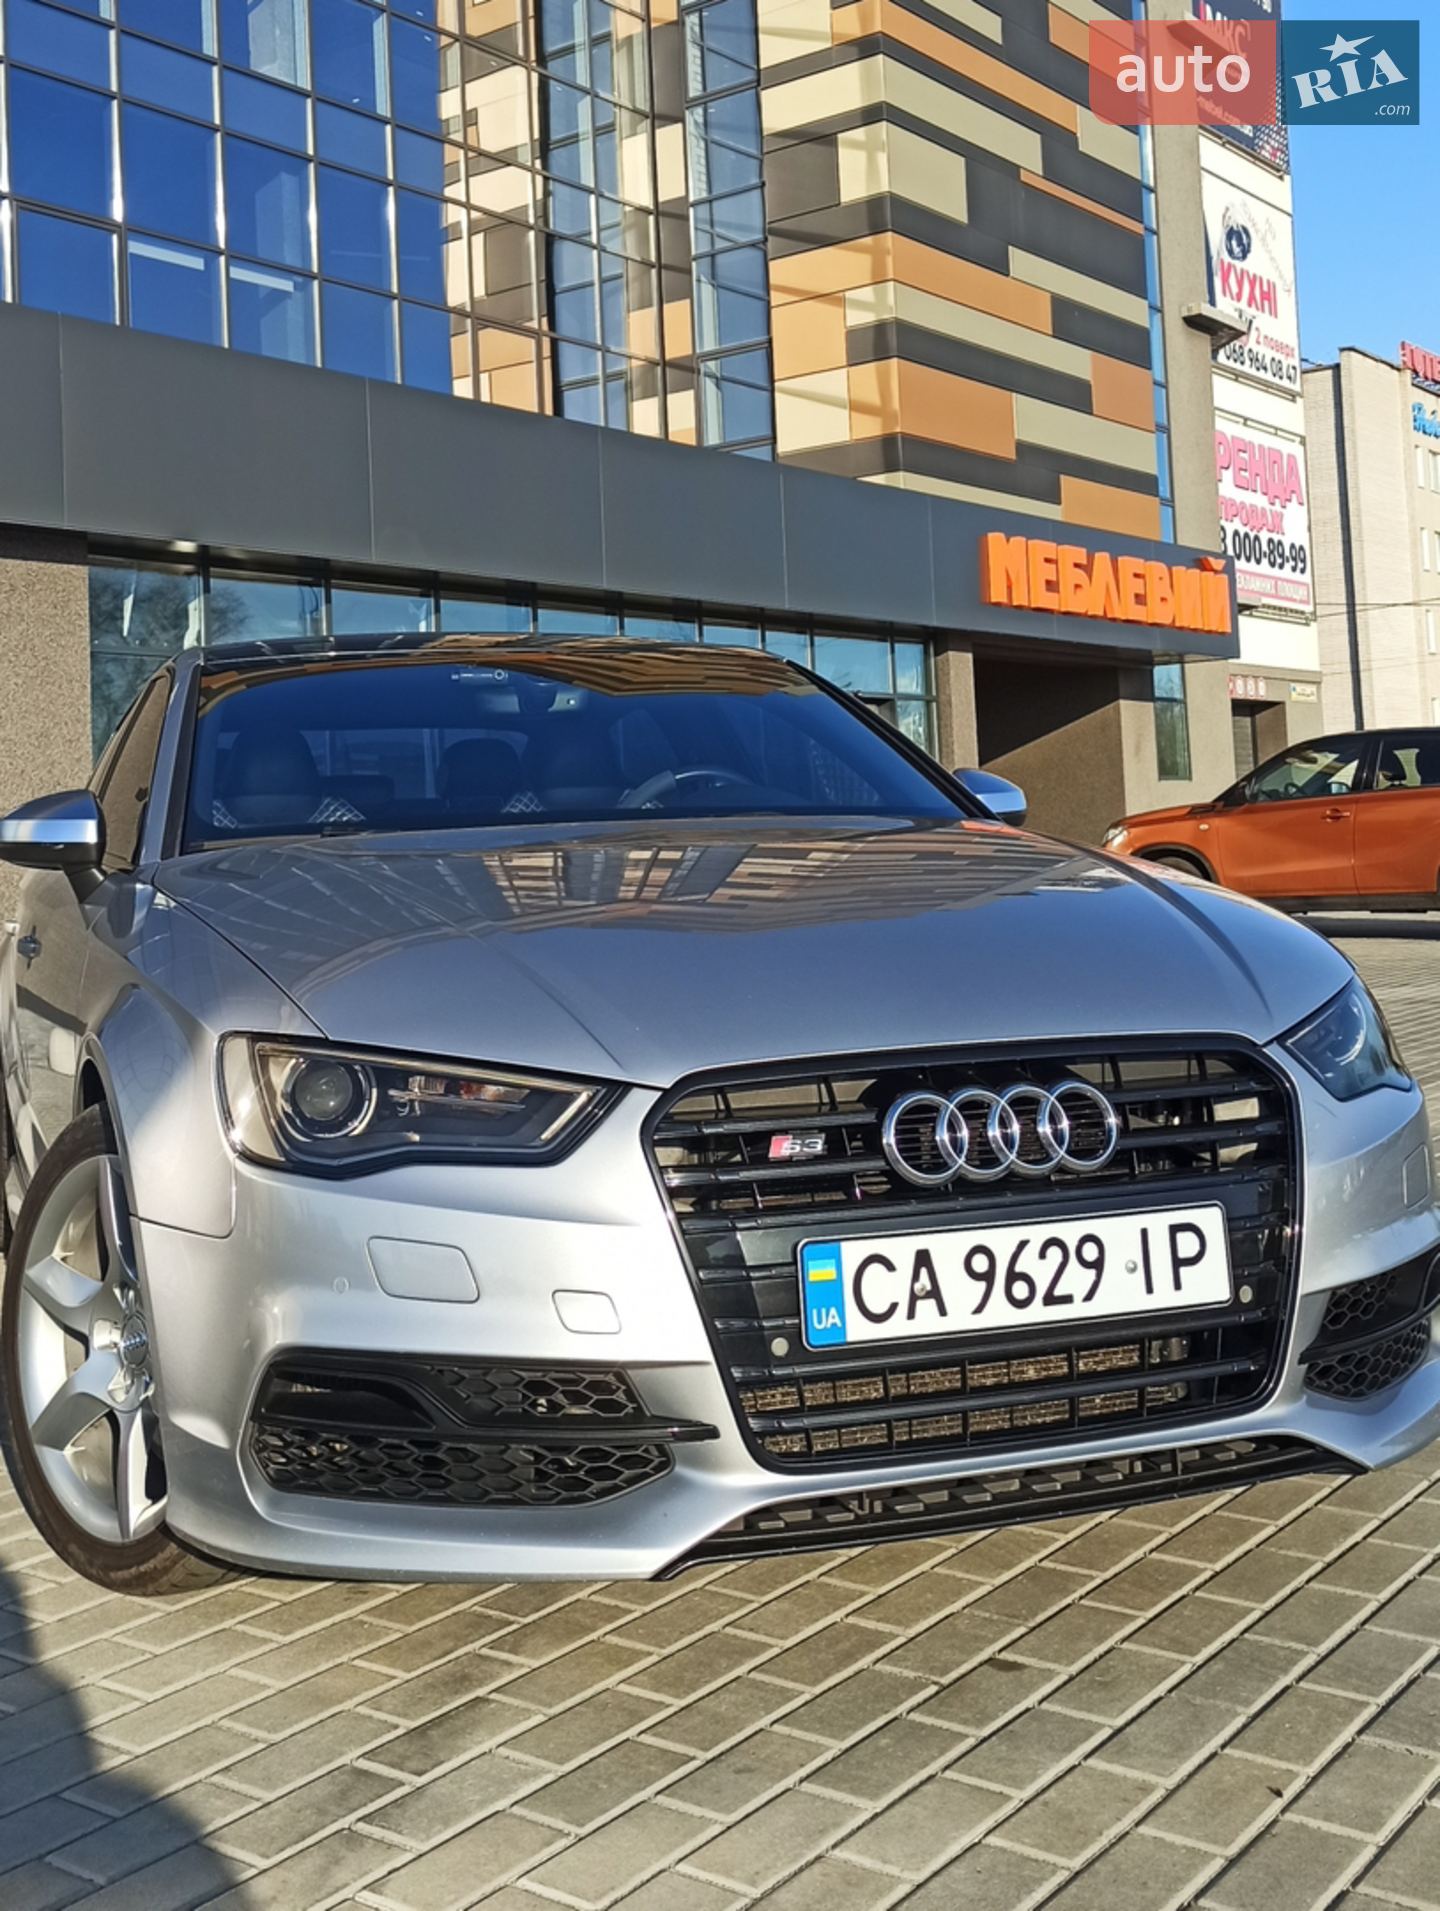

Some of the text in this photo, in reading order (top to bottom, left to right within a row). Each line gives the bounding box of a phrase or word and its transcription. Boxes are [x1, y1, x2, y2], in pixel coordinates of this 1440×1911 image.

[1219, 257, 1278, 319] КУХНІ
[1255, 326, 1262, 346] 2
[1224, 342, 1298, 385] 068 964 08 47
[1215, 430, 1304, 509] РЕНДА
[1218, 495, 1285, 536] ПРОДАЖ
[1232, 528, 1307, 575] 000-89-99
[982, 531, 1232, 635] МЕБЛЕВИЙ
[780, 1138, 823, 1153] S3
[852, 1222, 1207, 1324] CA 9629 IP
[813, 1308, 842, 1330] UA
